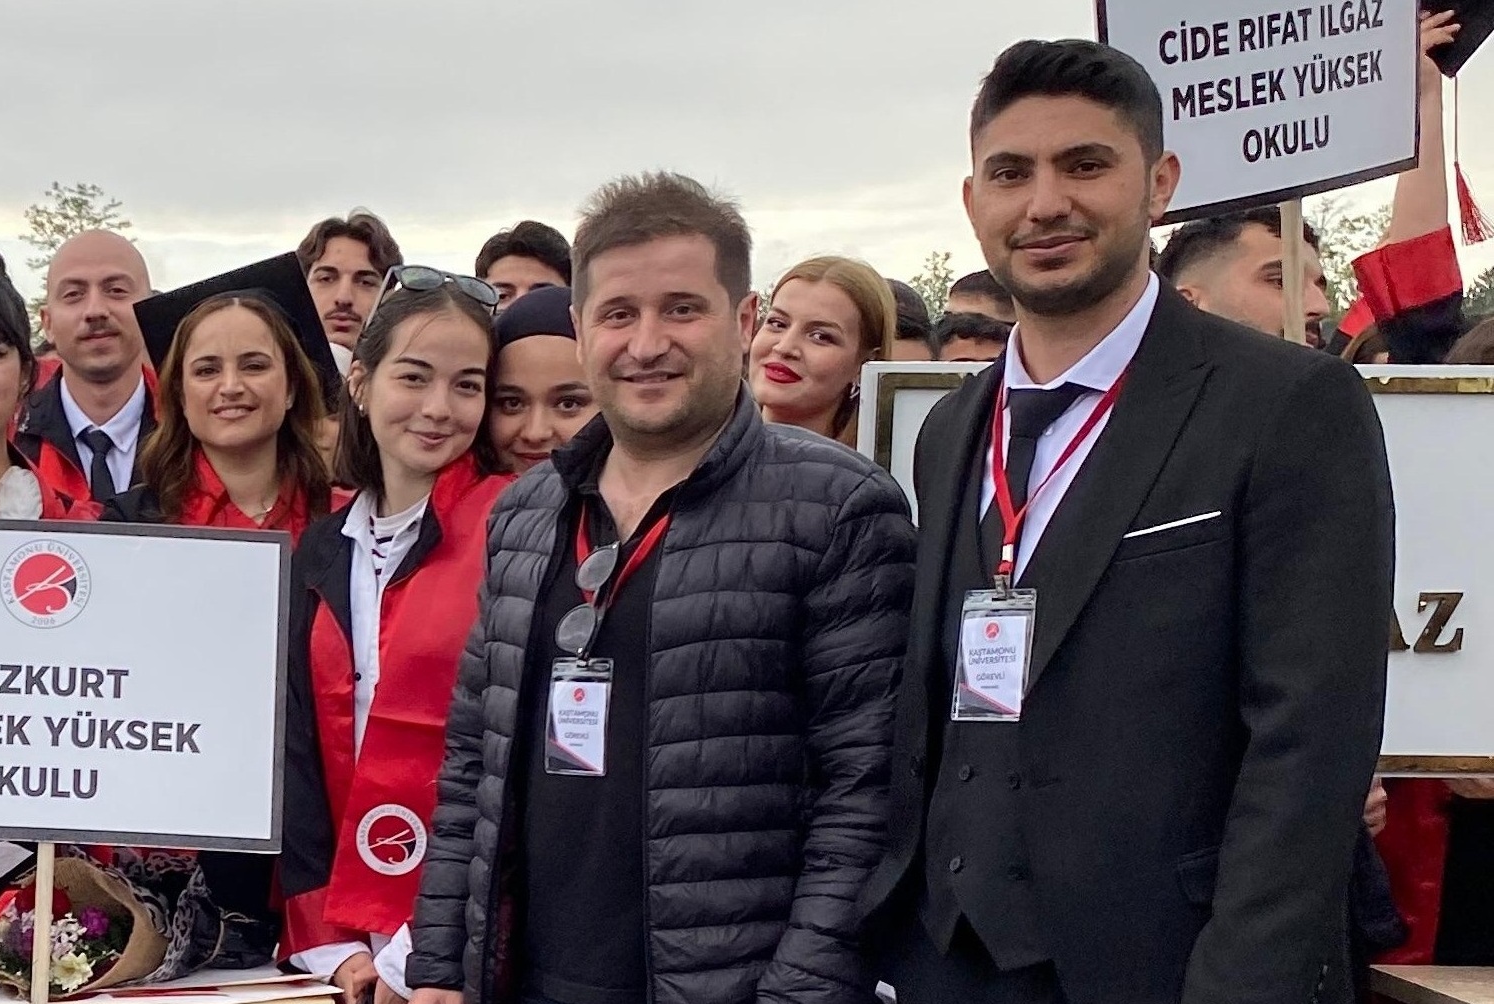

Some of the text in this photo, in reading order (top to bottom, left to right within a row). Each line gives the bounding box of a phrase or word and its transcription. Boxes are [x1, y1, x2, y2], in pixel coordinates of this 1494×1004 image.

[1159, 0, 1384, 65] CİDE RIFAT ILGAZ
[1172, 49, 1383, 121] MESLEK YÜKSEK
[1243, 115, 1330, 163] OKULU
[44, 710, 201, 753] YÜKSEK
